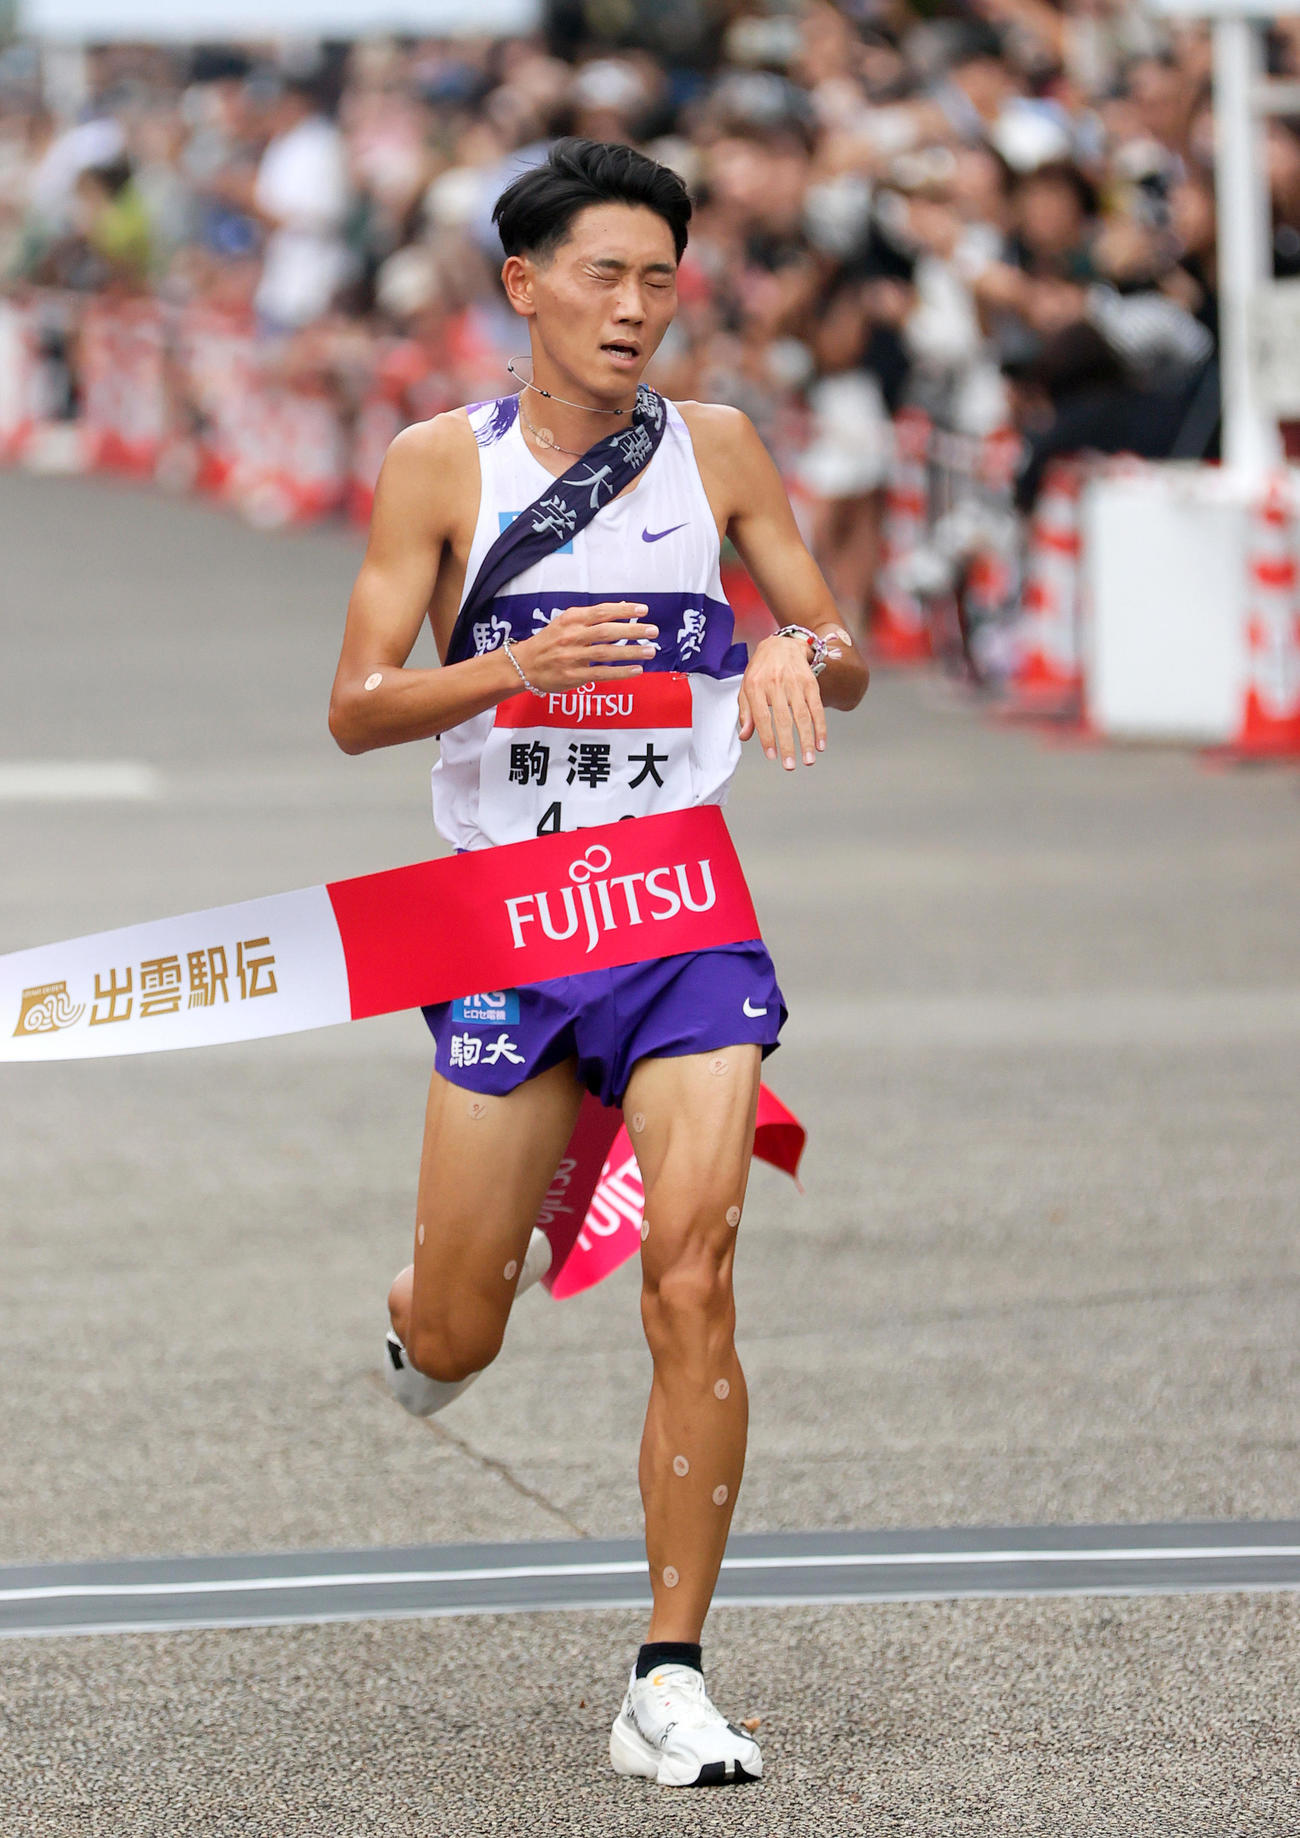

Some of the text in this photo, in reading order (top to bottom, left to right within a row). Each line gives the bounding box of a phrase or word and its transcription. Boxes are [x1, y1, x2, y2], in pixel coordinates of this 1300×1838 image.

[548, 692, 634, 723] FUJITSU
[508, 740, 669, 789] 駒澤大
[504, 859, 717, 954] FUJITSU
[89, 936, 278, 1027] 出雲駅伝
[449, 1032, 526, 1068] 駒大
